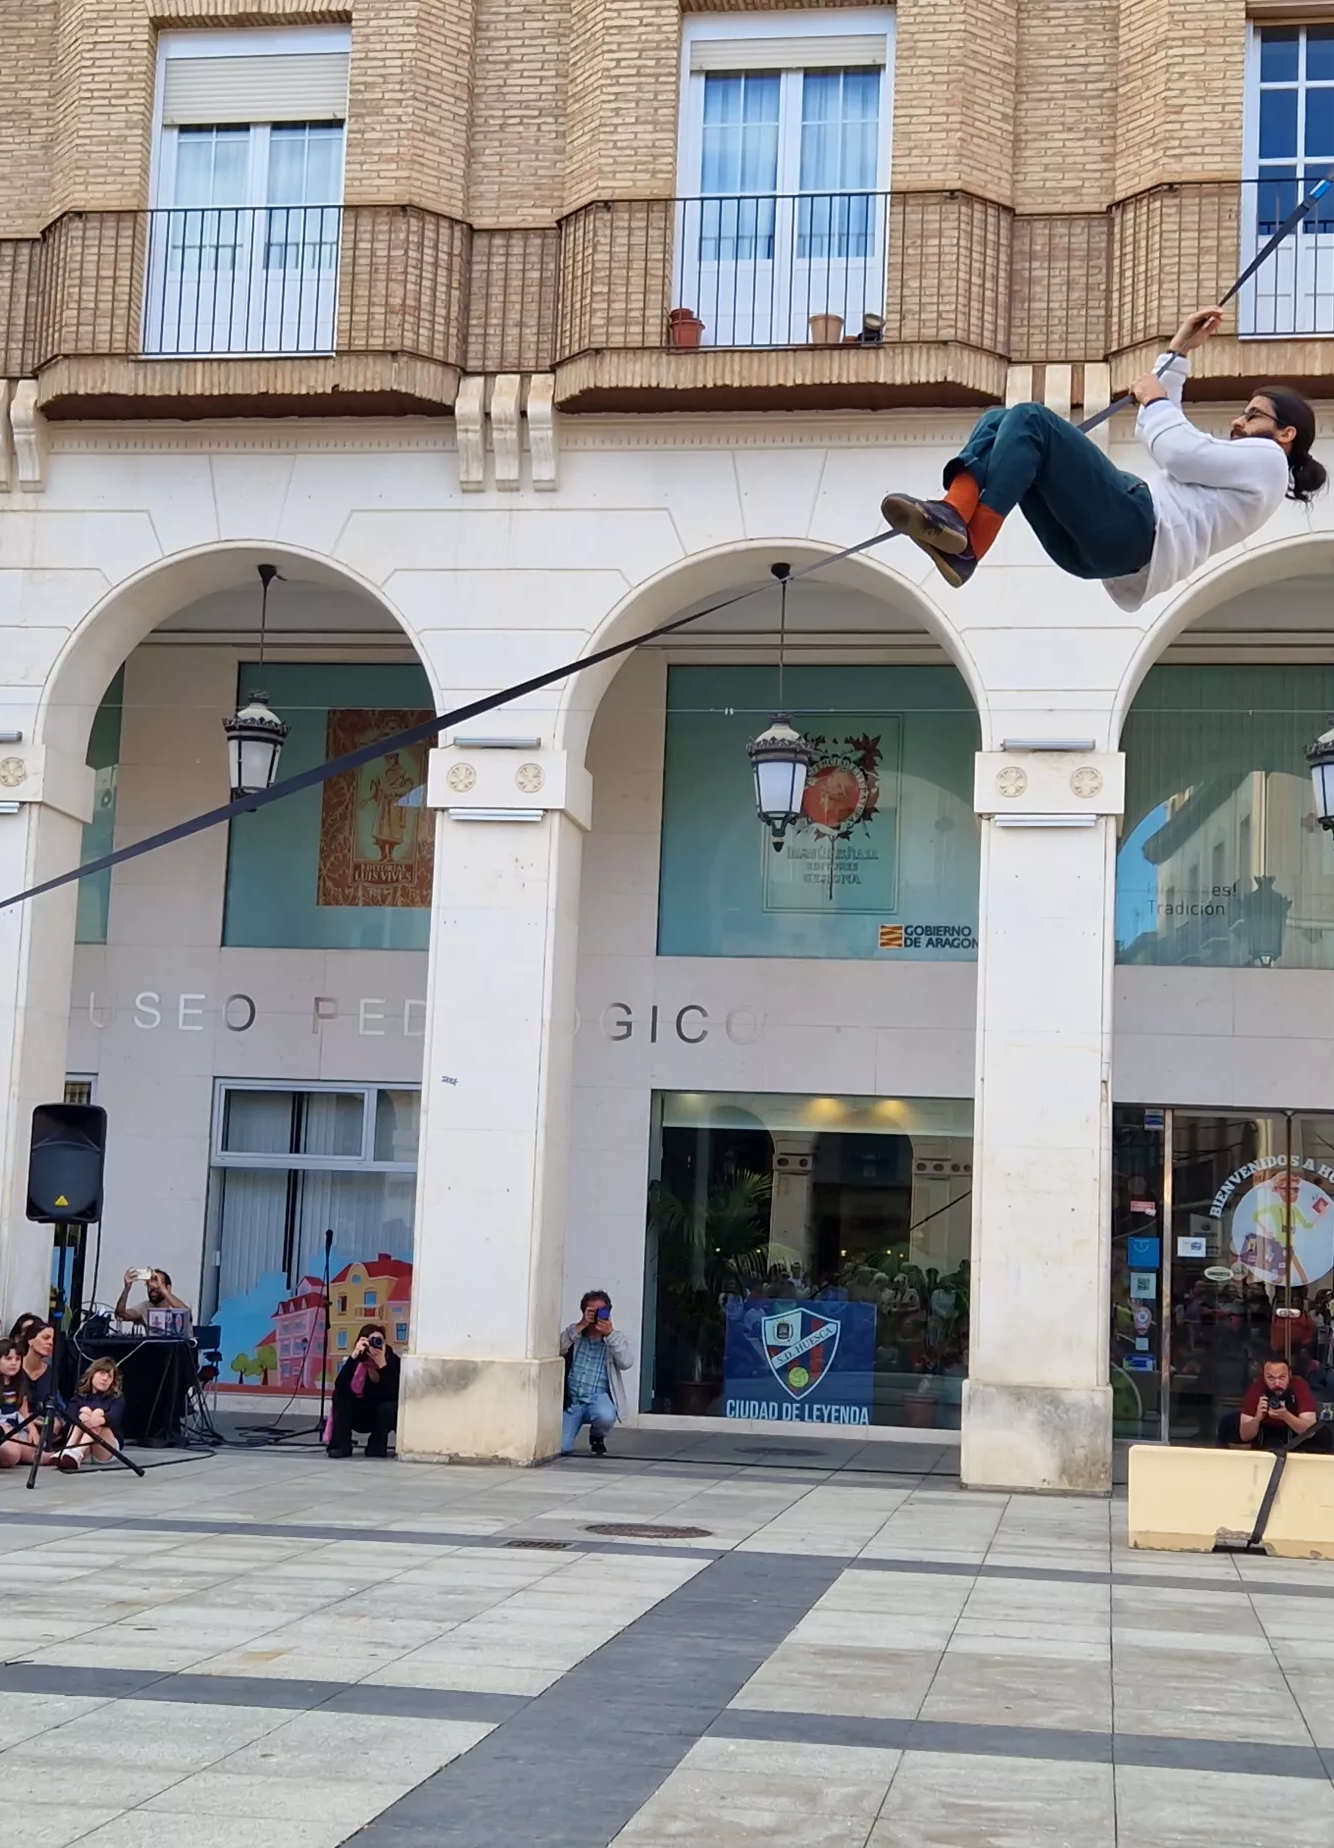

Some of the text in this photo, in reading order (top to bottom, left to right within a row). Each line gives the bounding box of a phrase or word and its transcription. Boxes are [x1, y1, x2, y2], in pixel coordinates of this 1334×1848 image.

[355, 871, 412, 881] LUIS VIVES
[361, 863, 407, 872] EDITORIAL
[1147, 899, 1225, 916] Tradición
[904, 924, 972, 937] GOBIERNO
[904, 937, 921, 948] DE
[87, 991, 256, 1032] USEO
[1209, 1154, 1300, 1219] BIENVENIDOS
[1302, 1158, 1316, 1172] A
[776, 1326, 833, 1365] S.D. HUESCA
[726, 1399, 869, 1425] CIUDAD DE LEYENDA
